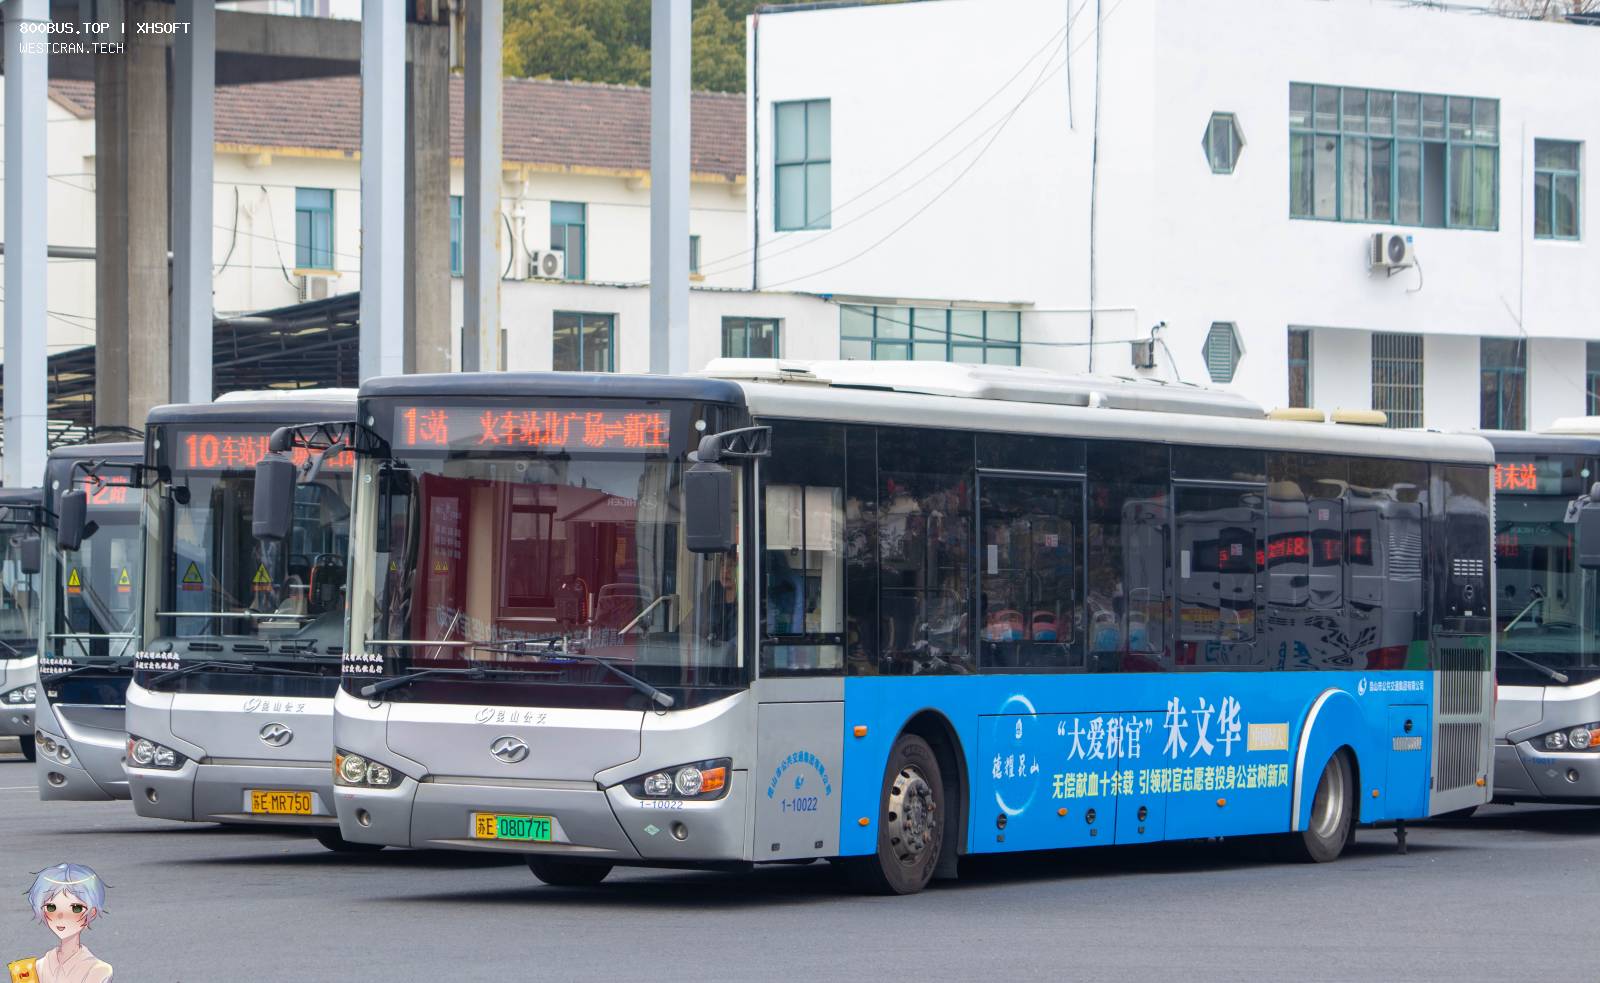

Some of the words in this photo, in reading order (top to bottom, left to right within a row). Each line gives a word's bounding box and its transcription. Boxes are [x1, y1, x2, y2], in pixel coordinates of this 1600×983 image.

[403, 407, 417, 447] 1
[185, 433, 220, 467] 10
[496, 711, 548, 725] 昆山公交
[1162, 695, 1242, 761] 朱文华
[1052, 769, 1134, 800] 无偿献血十余载
[1138, 763, 1290, 796] 引领税官志愿者投身公益树新风
[639, 800, 684, 810] 1-10022
[781, 796, 818, 813] 1-10022
